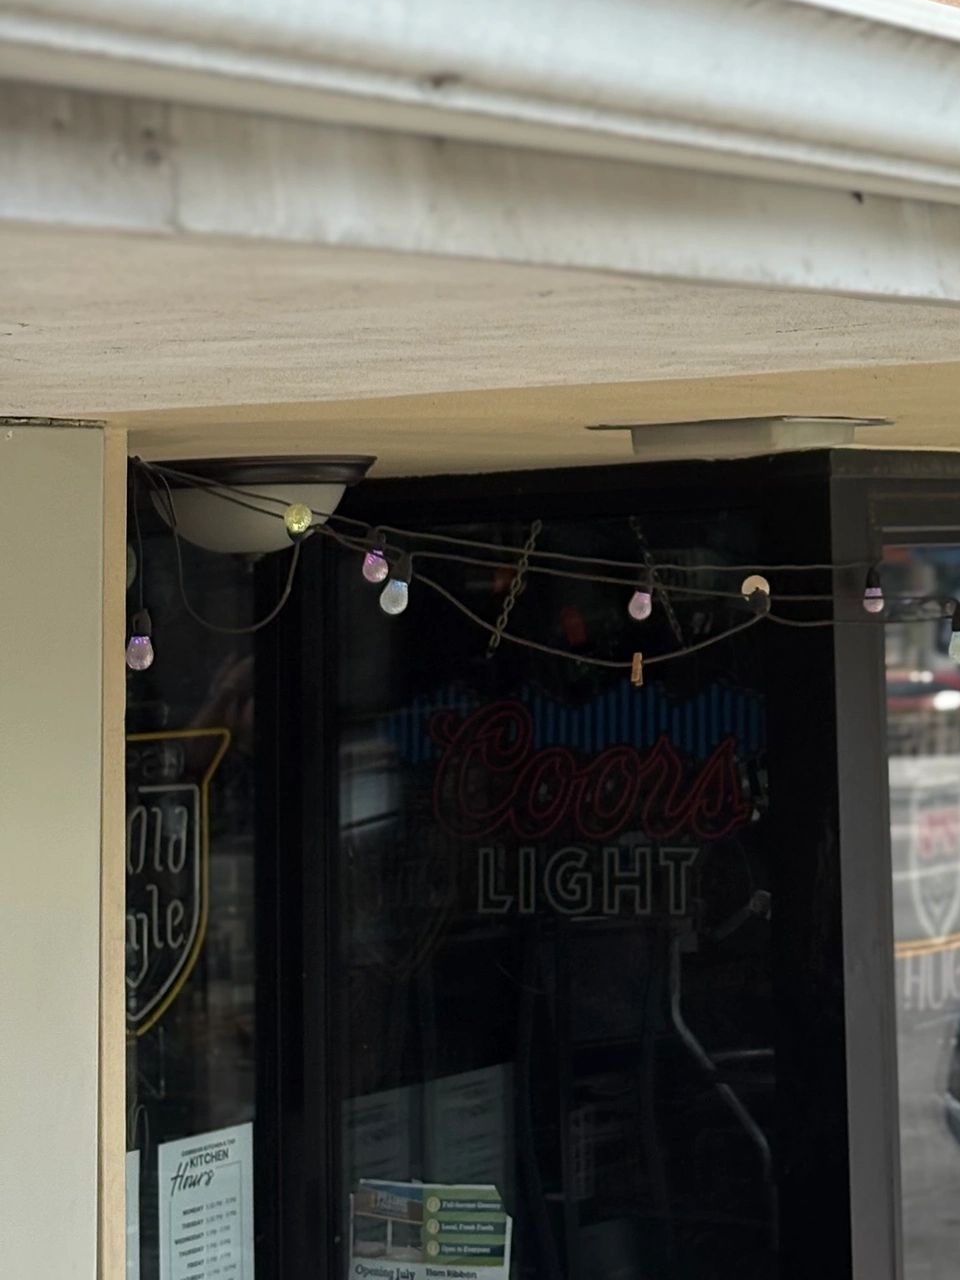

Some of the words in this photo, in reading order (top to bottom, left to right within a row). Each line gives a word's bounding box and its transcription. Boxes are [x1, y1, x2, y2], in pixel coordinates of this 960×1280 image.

[428, 699, 755, 840] Coors
[477, 845, 699, 916] LIGHT
[188, 1148, 230, 1169] KITCHEN
[170, 1161, 214, 1197] Hours
[355, 1263, 394, 1280] Opening
[396, 1265, 416, 1280] July
